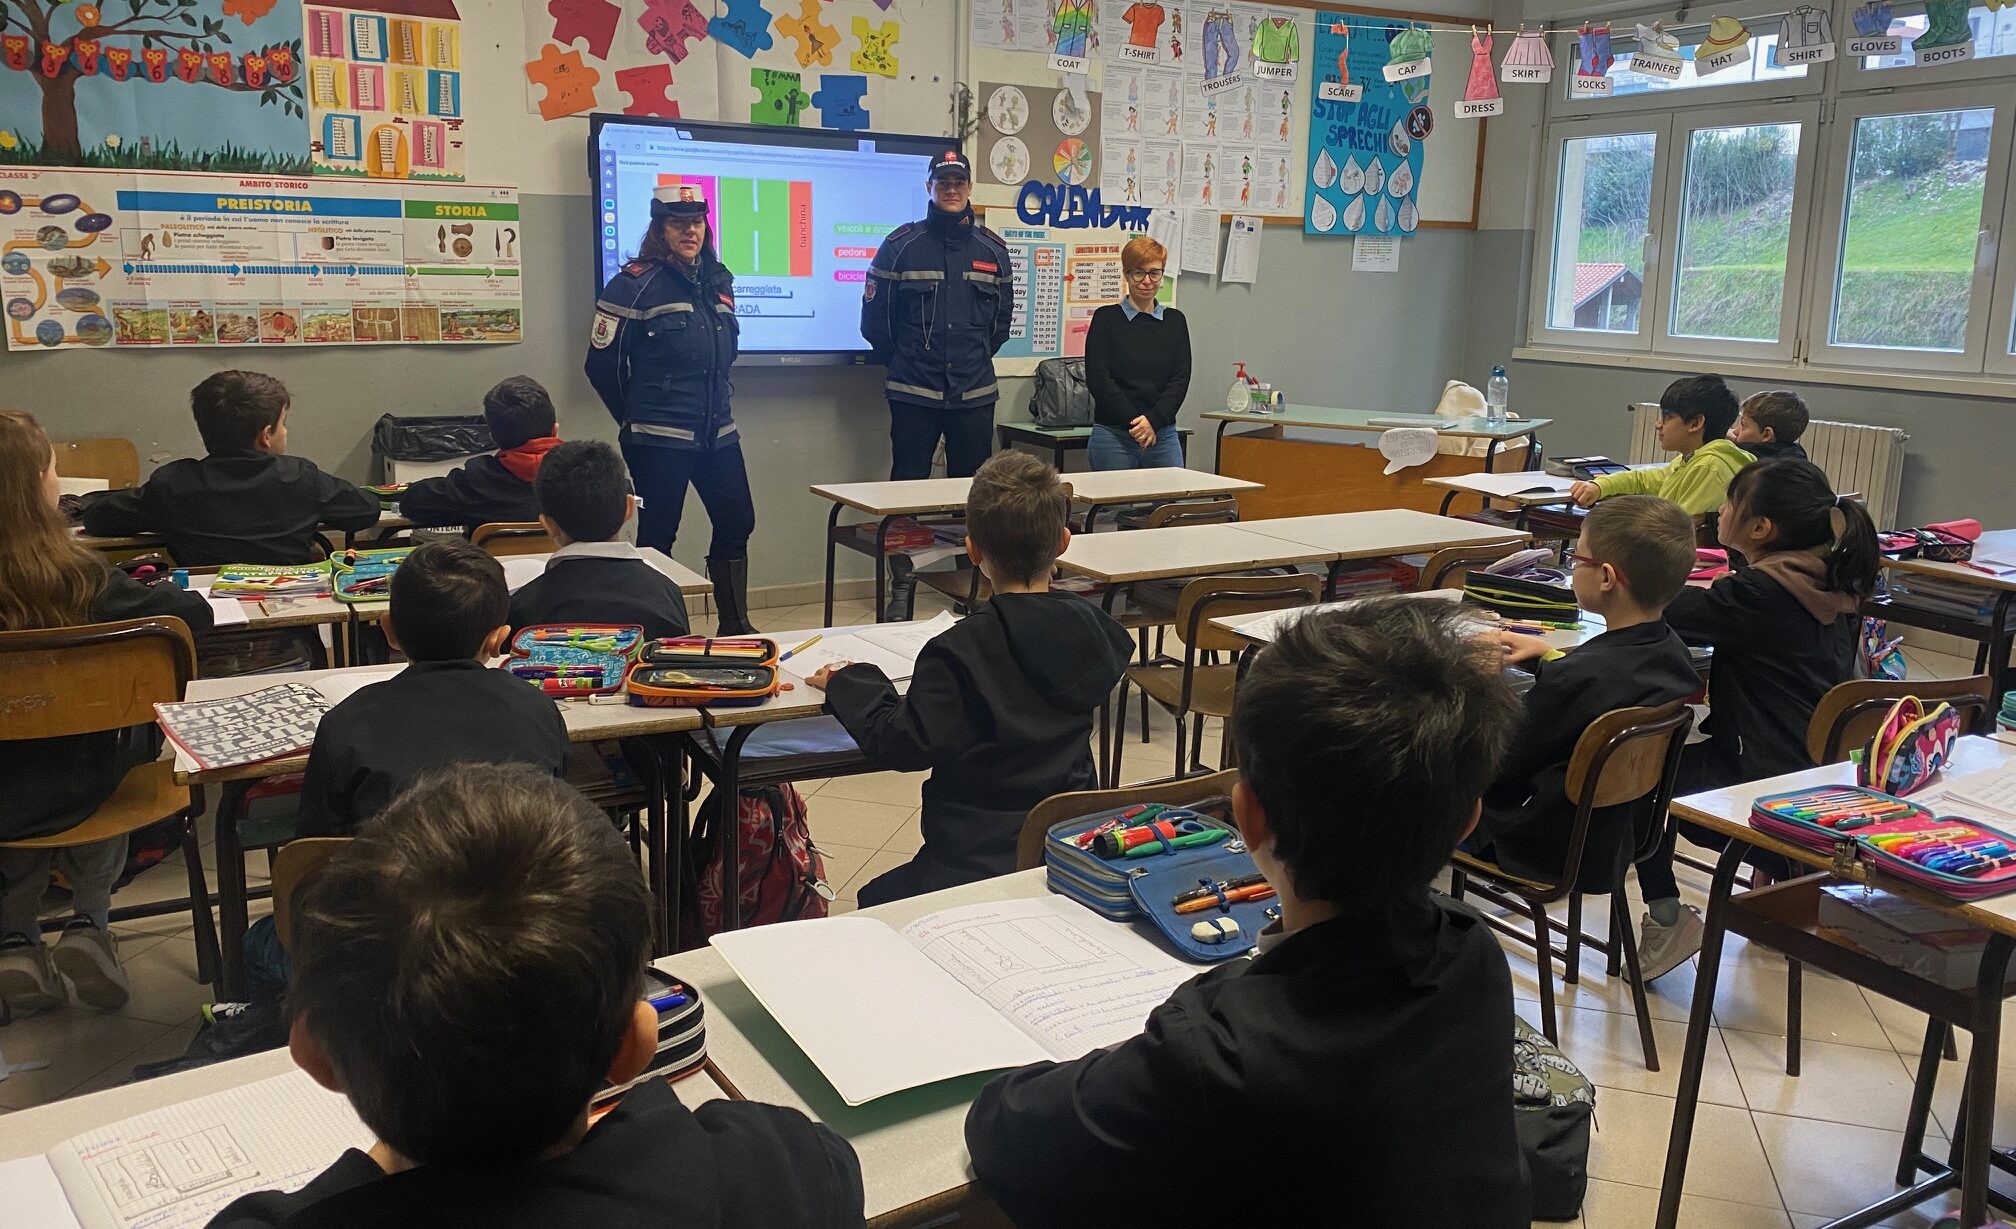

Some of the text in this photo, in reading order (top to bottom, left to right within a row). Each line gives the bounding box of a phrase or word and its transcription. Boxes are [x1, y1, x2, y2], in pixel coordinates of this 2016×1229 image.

[1851, 41, 1896, 52] GLOVES
[1124, 48, 1155, 60] T-SHIRT
[1789, 50, 1823, 61] SHIRT
[1923, 48, 1966, 62] BOOTS
[1057, 59, 1080, 69] COAT
[1710, 53, 1733, 68] HAT
[12, 53, 291, 84] 2 3 4 5 6 7 8 9 10
[1257, 65, 1292, 76] JUMPER
[1398, 65, 1416, 76] CAP
[1633, 58, 1680, 75] TRAINERS
[1512, 69, 1540, 78] SKIRT
[1203, 74, 1240, 91] TROUSERS
[1578, 80, 1606, 89] SOCKS
[1328, 88, 1355, 98] SCARF
[1464, 103, 1494, 113] DRESS
[1357, 102, 1392, 131] AGLI
[1325, 124, 1389, 153] SPRECHI
[217, 198, 312, 212] PREISTORIA
[435, 205, 487, 216] STORIA
[193, 215, 221, 223] periodo
[837, 224, 864, 233] veicoli
[838, 249, 866, 258] pedoni
[733, 285, 782, 295] carreggiata
